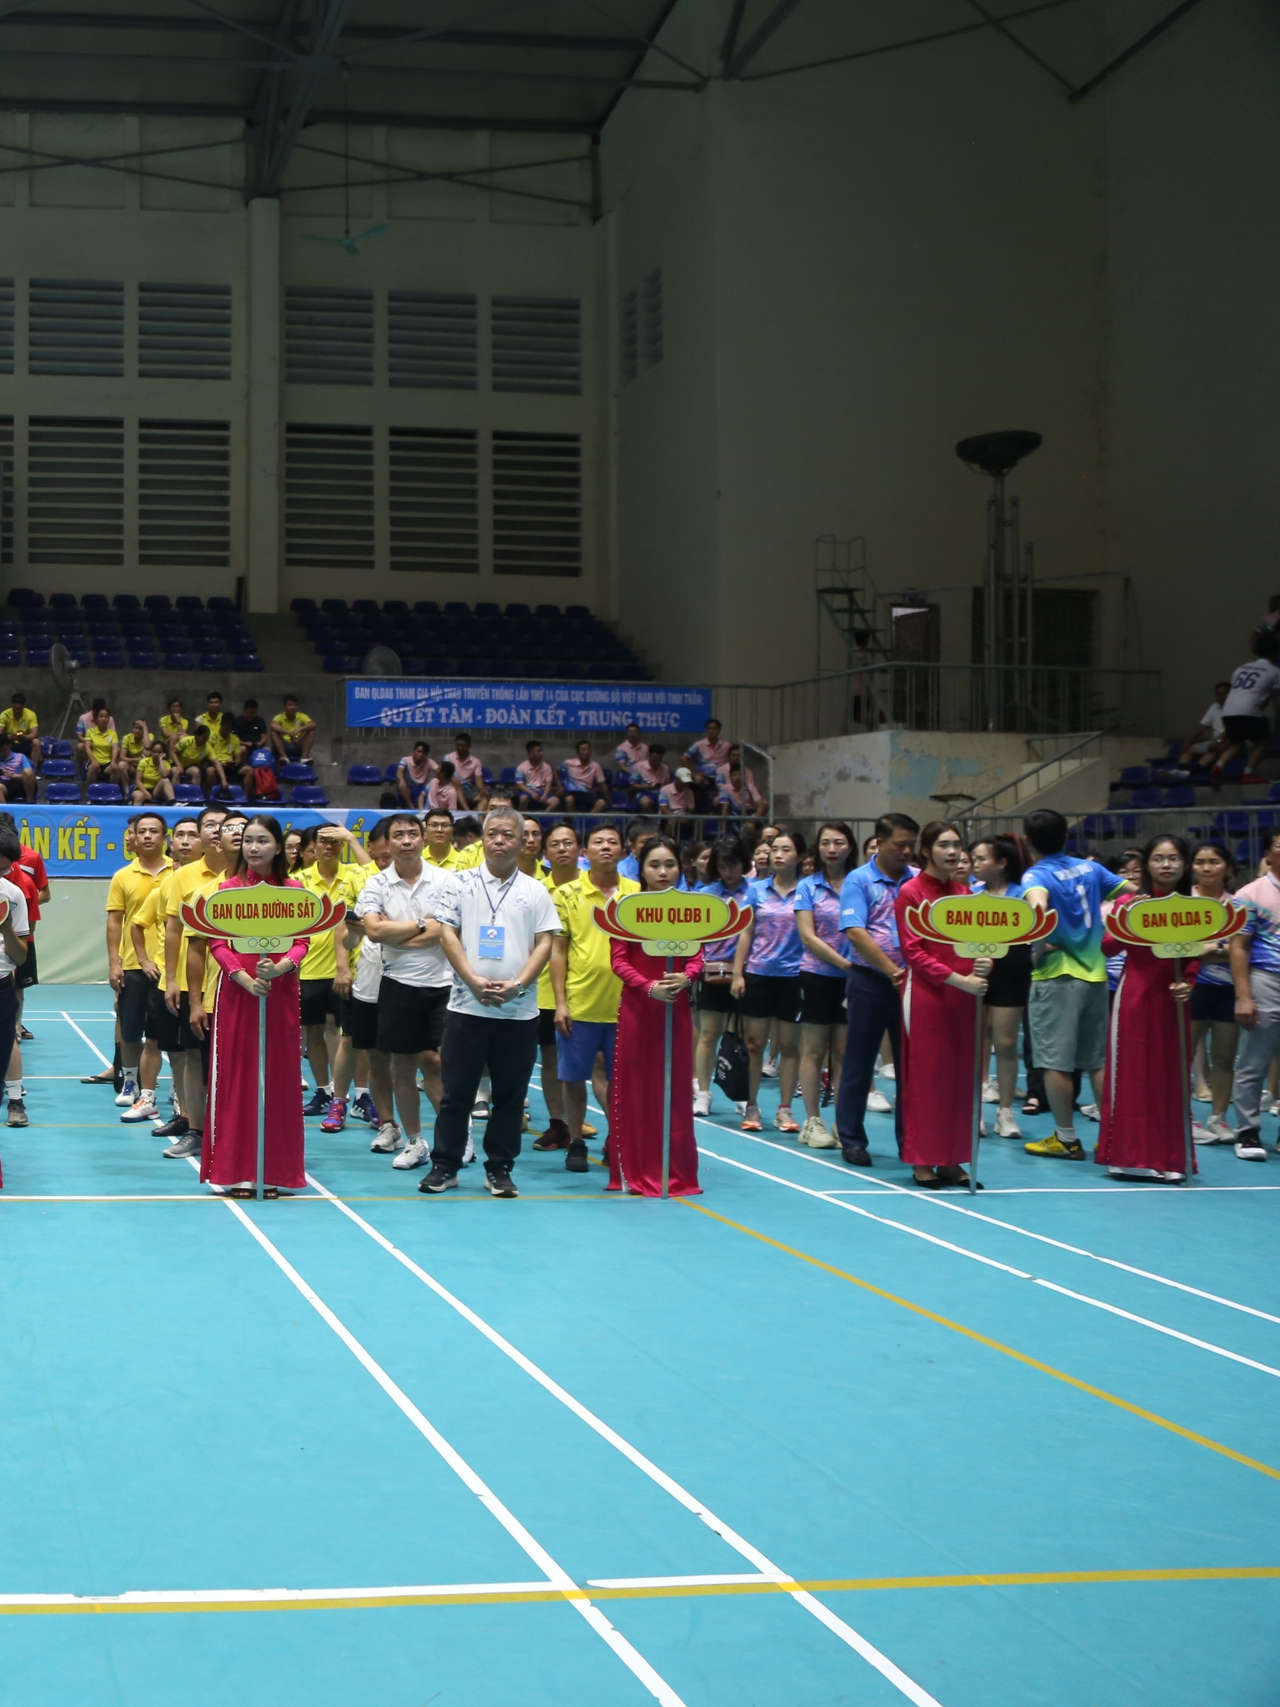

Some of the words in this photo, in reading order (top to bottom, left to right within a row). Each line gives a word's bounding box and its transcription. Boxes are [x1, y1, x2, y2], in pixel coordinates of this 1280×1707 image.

[1232, 671, 1261, 690] 66
[355, 687, 369, 700] BAN
[396, 687, 416, 700] THAM
[380, 700, 435, 726] QUYẾT
[439, 703, 473, 724] TÂM
[485, 704, 531, 725] ĐOÀN
[535, 703, 567, 725] KẾT
[578, 710, 633, 726] TRUNG
[637, 711, 681, 731] THỰC
[57, 816, 100, 860] KẾT
[212, 903, 232, 920] BAN
[235, 903, 259, 921] QLDA
[262, 898, 294, 919] ĐƯỜNG
[297, 896, 316, 918] SẮT
[636, 907, 663, 923] KHU
[668, 907, 702, 925] QLĐB
[706, 908, 711, 923] I
[946, 910, 972, 926] BAN
[977, 910, 1008, 928] QLDA
[1012, 912, 1020, 927] 3
[1142, 913, 1167, 929] BAN
[1171, 911, 1202, 928] QLDA
[1205, 911, 1212, 925] 5
